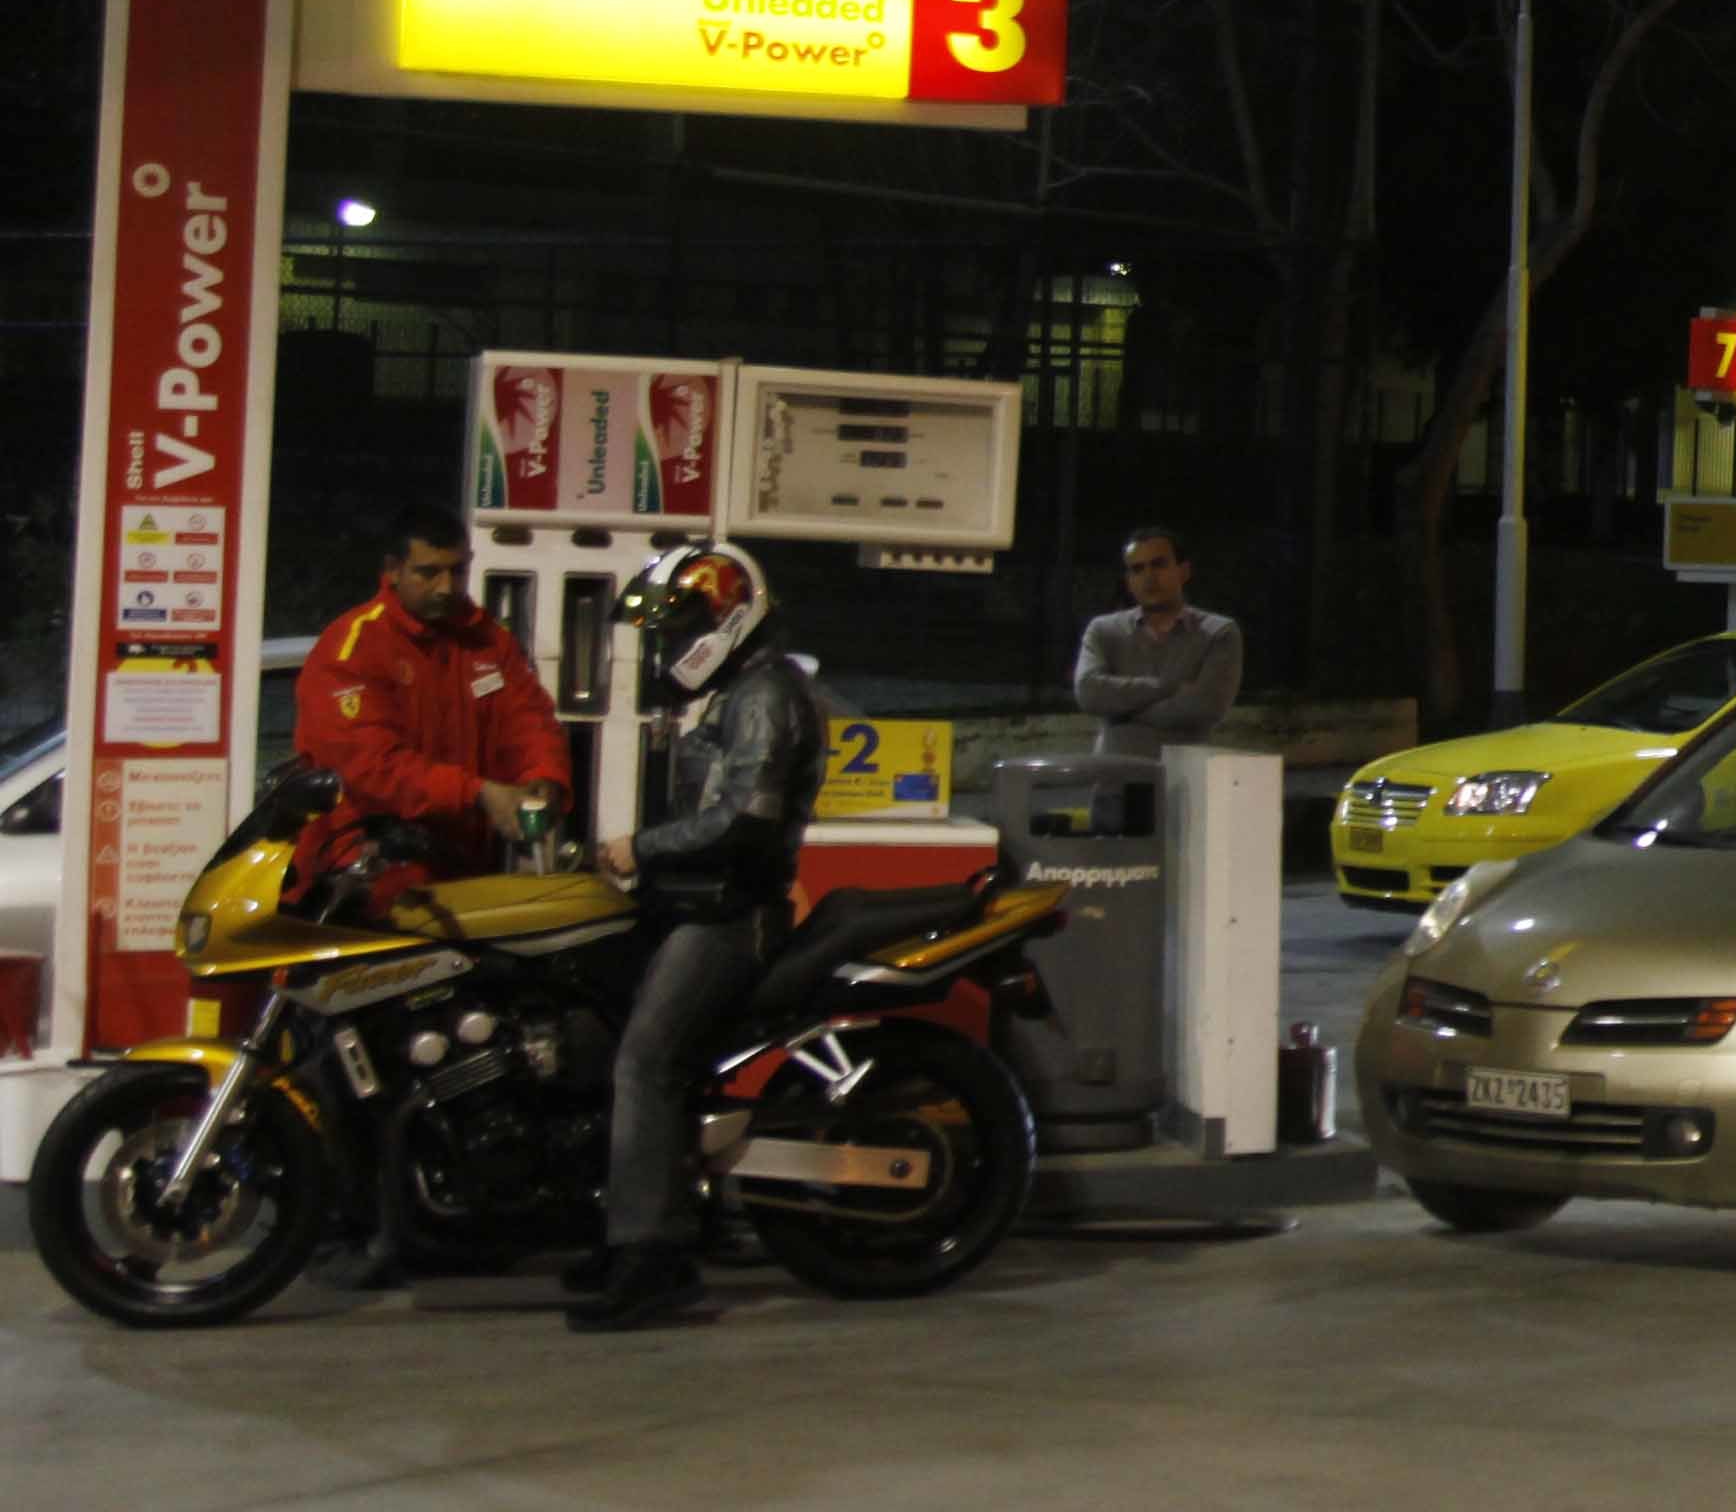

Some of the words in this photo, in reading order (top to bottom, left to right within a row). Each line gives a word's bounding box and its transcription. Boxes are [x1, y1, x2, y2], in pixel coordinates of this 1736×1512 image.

[699, 27, 869, 68] V-Power
[152, 180, 229, 490] V-Power
[126, 431, 146, 490] Shell
[586, 391, 610, 495] Unleaded
